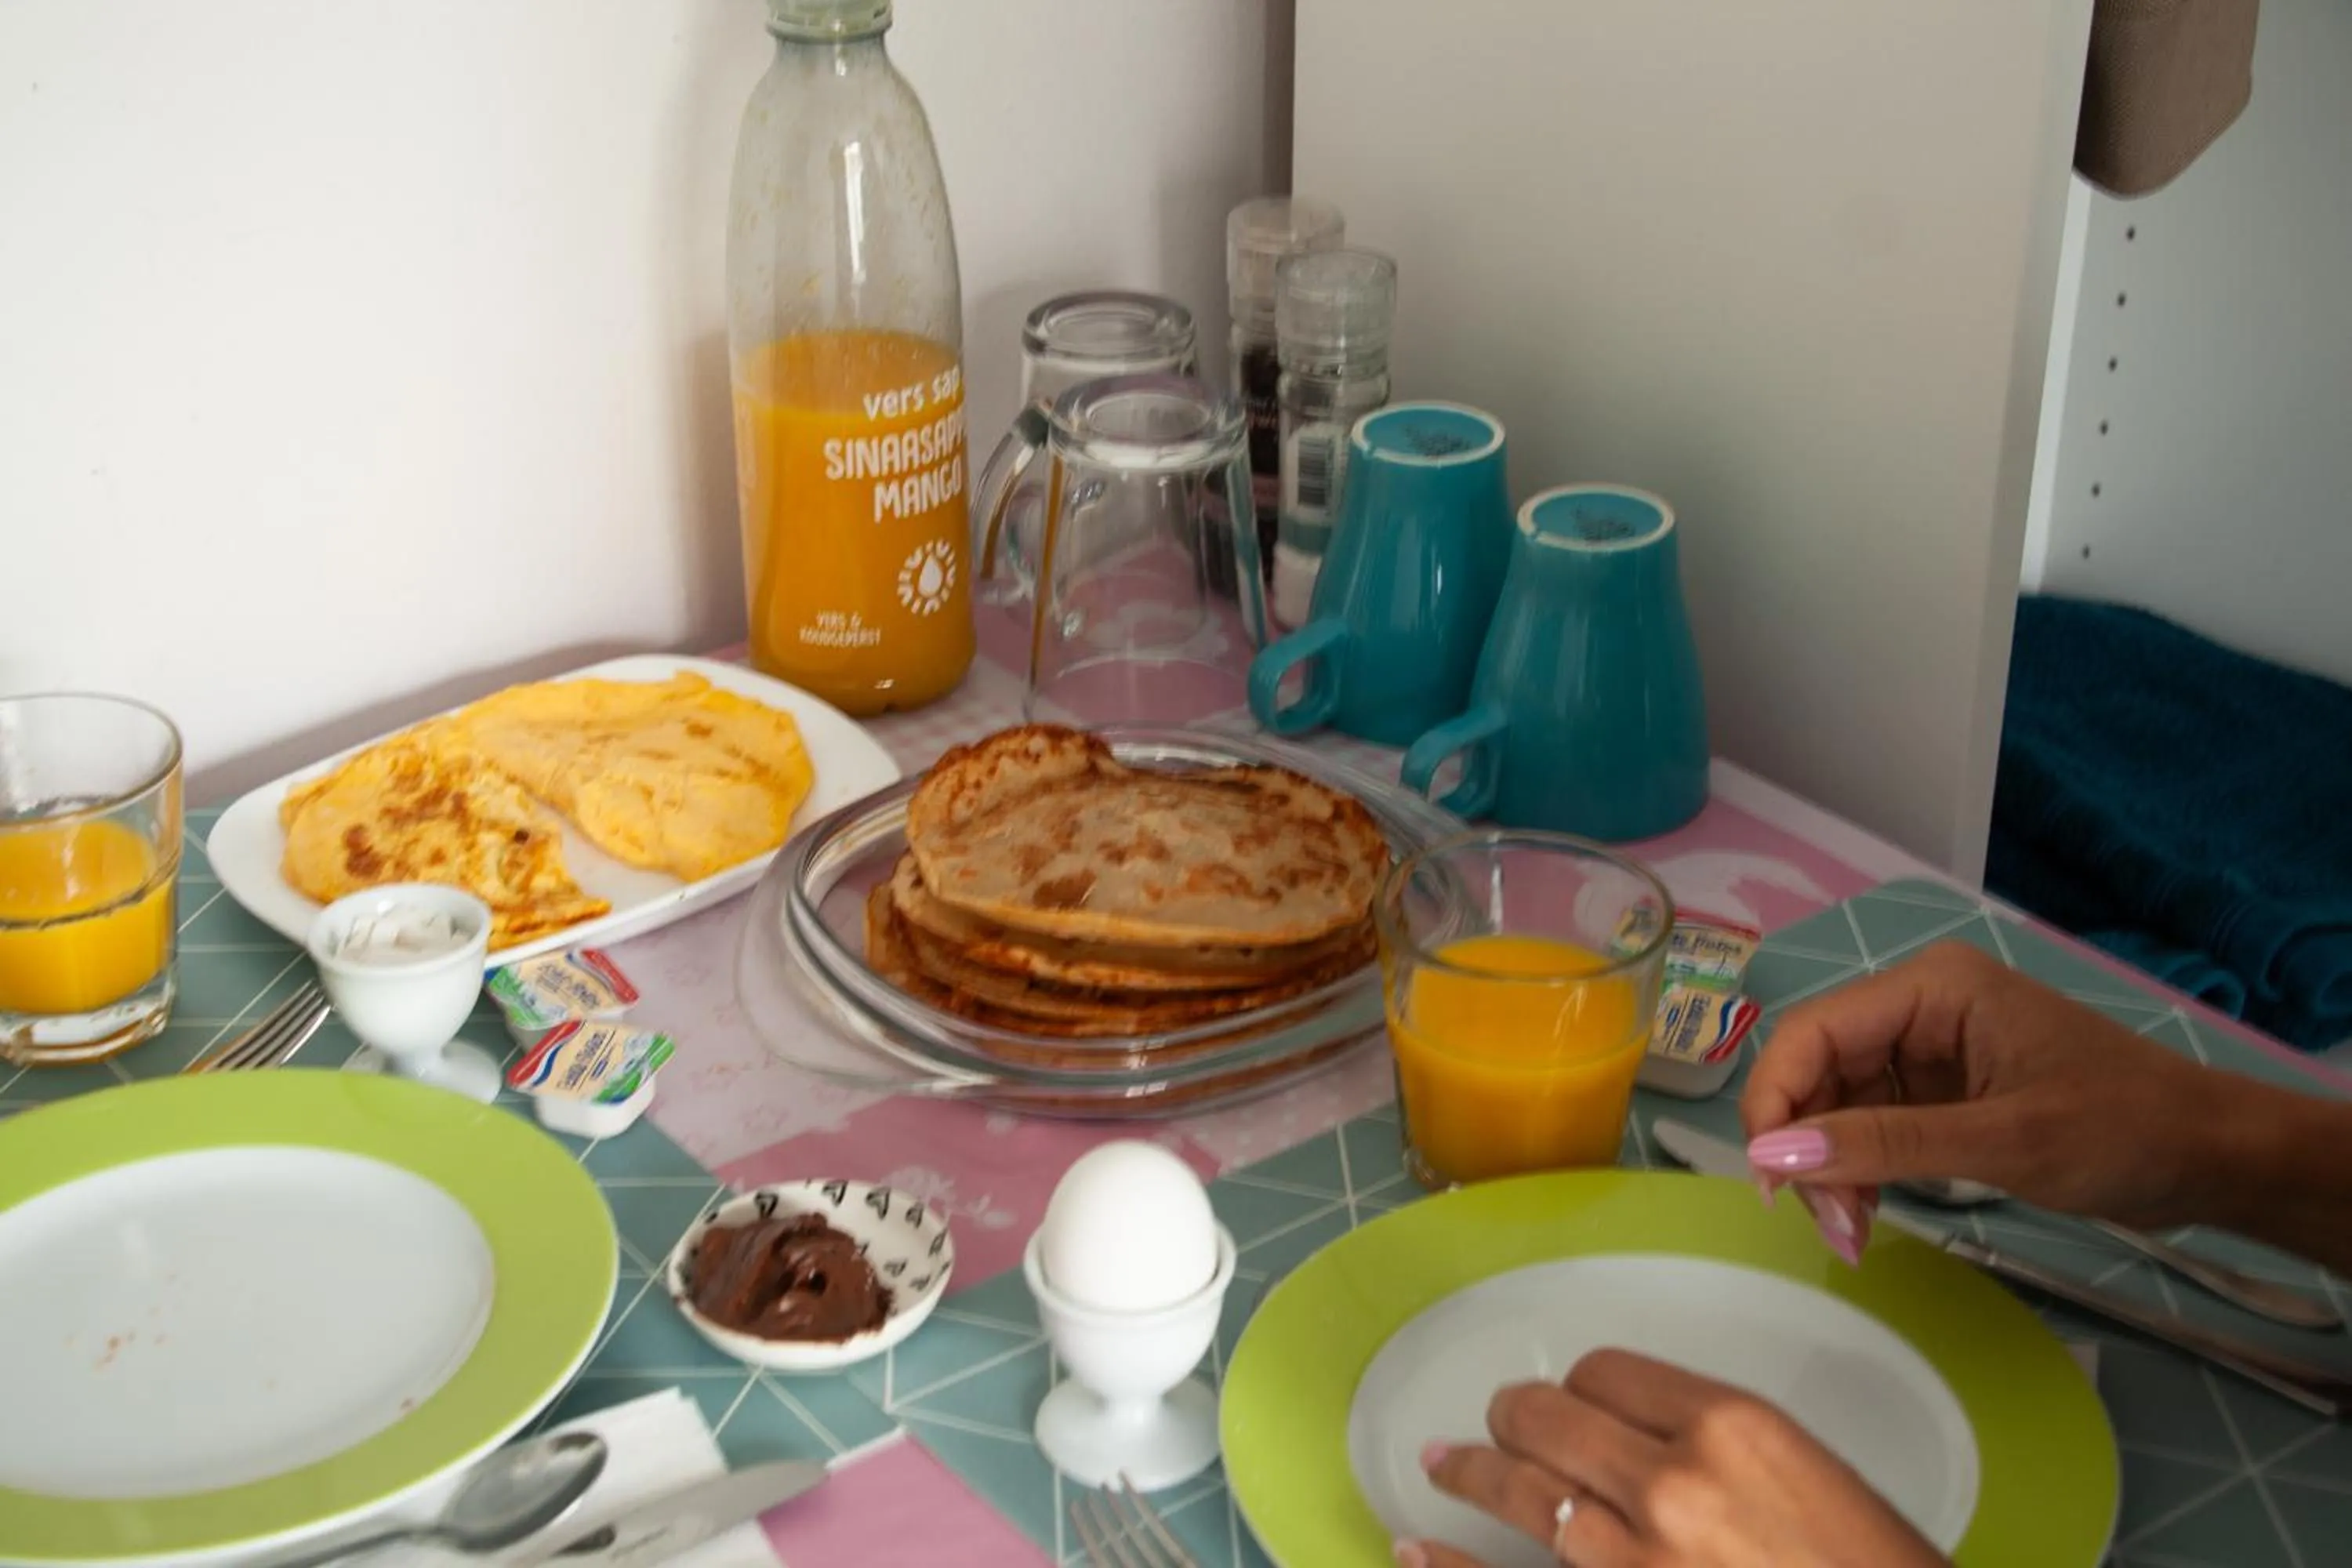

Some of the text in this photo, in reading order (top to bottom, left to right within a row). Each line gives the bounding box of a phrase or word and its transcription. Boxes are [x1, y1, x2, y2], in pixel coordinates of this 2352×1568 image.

[864, 365, 960, 421] vers sap
[875, 455, 962, 523] MANGO
